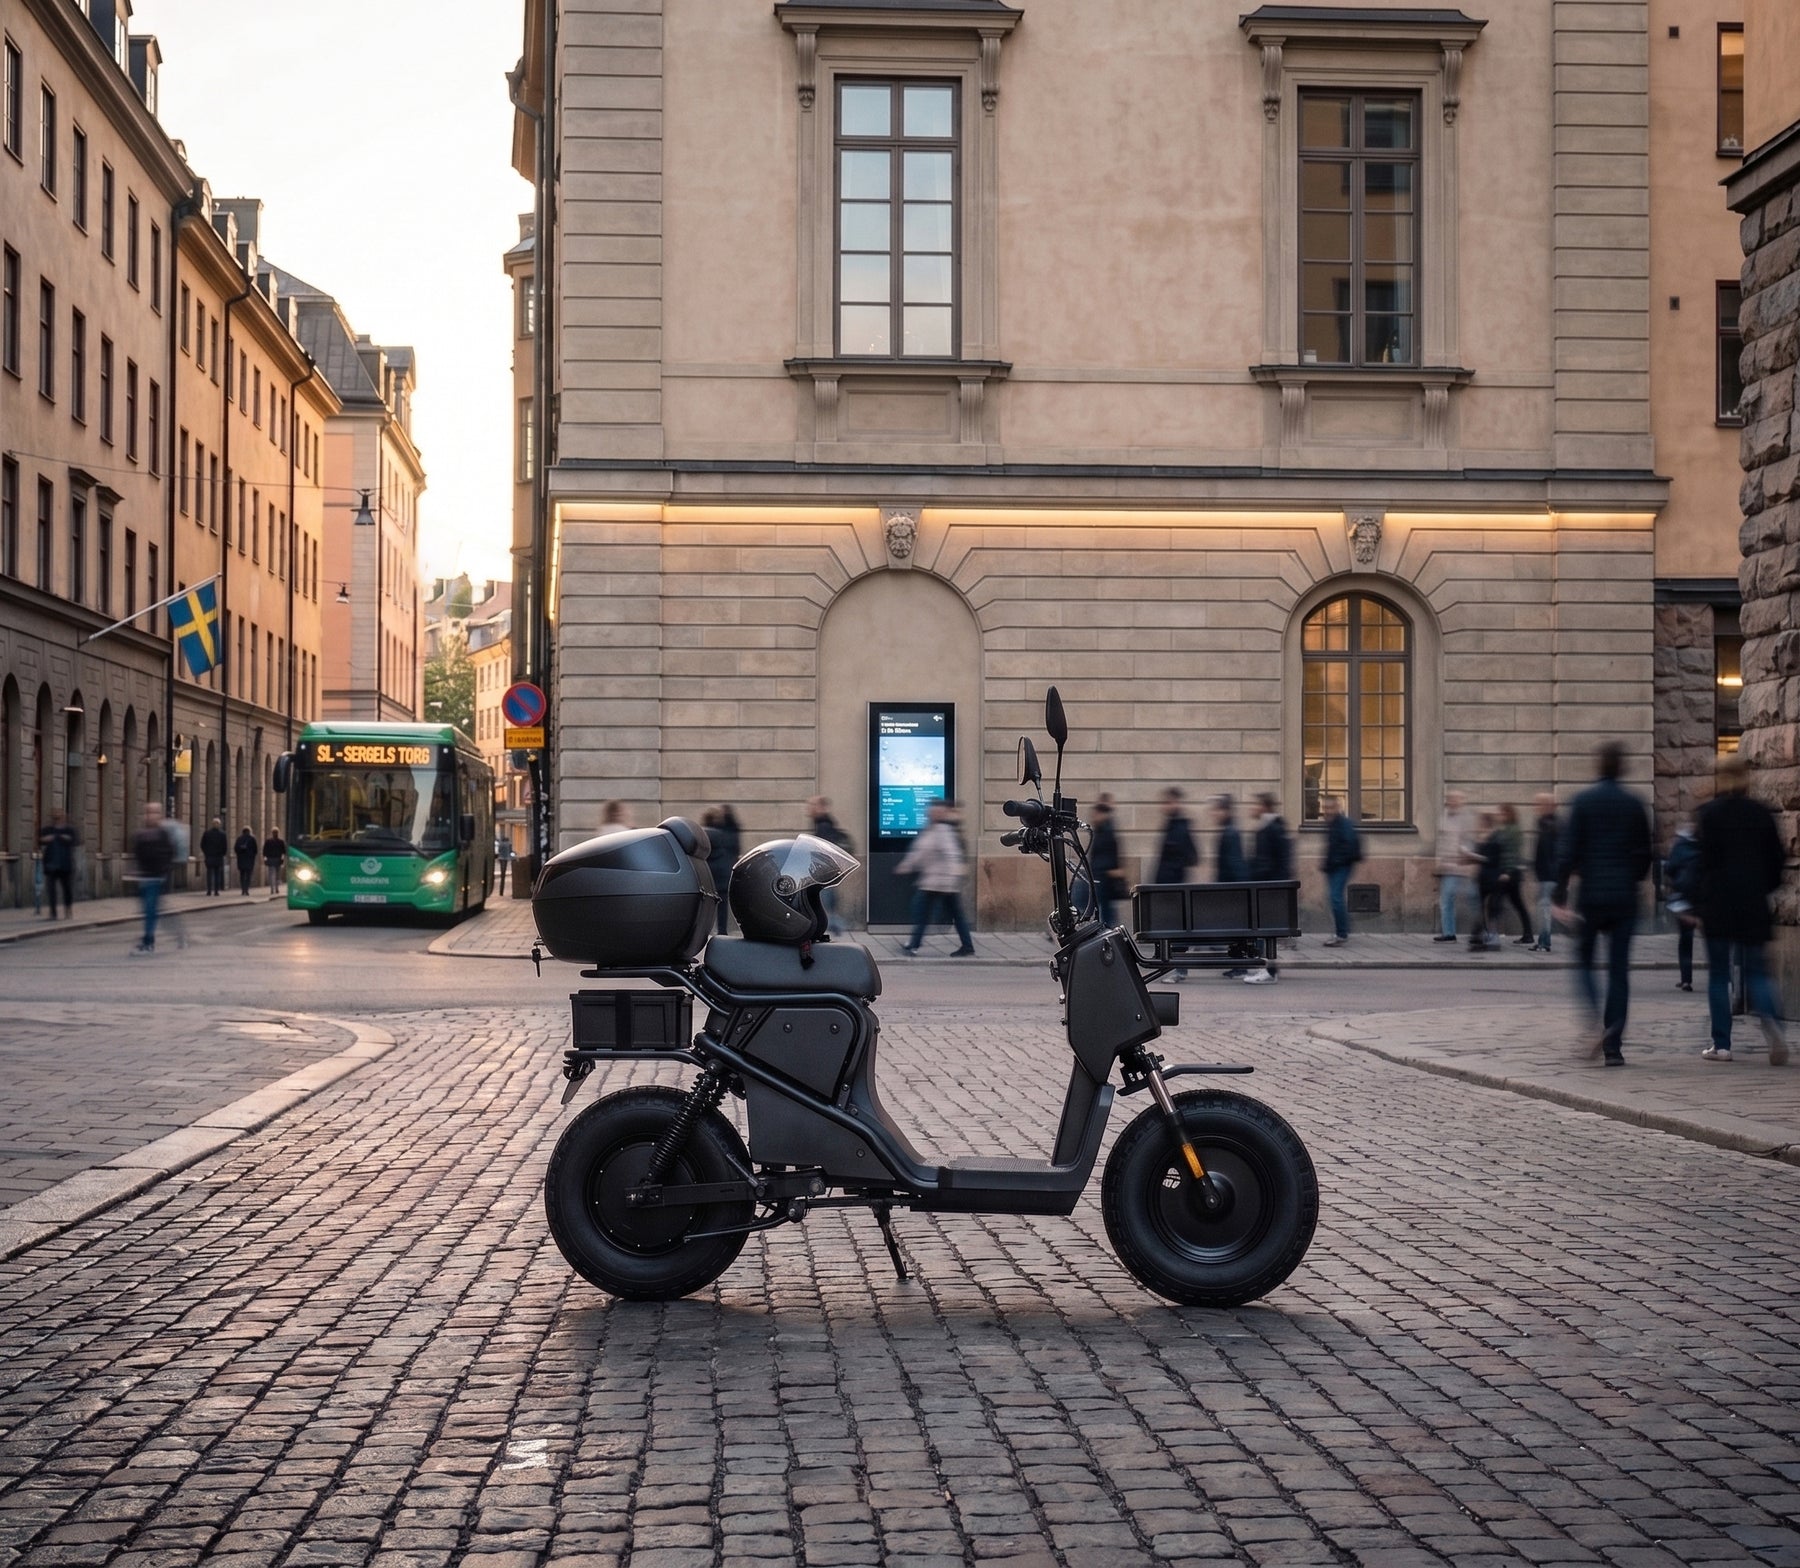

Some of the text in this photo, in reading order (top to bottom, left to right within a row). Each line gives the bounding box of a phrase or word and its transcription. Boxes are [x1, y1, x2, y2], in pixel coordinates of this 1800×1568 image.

[317, 744, 335, 762] SL
[343, 745, 396, 763] SERGELS
[397, 746, 430, 764] TORG
